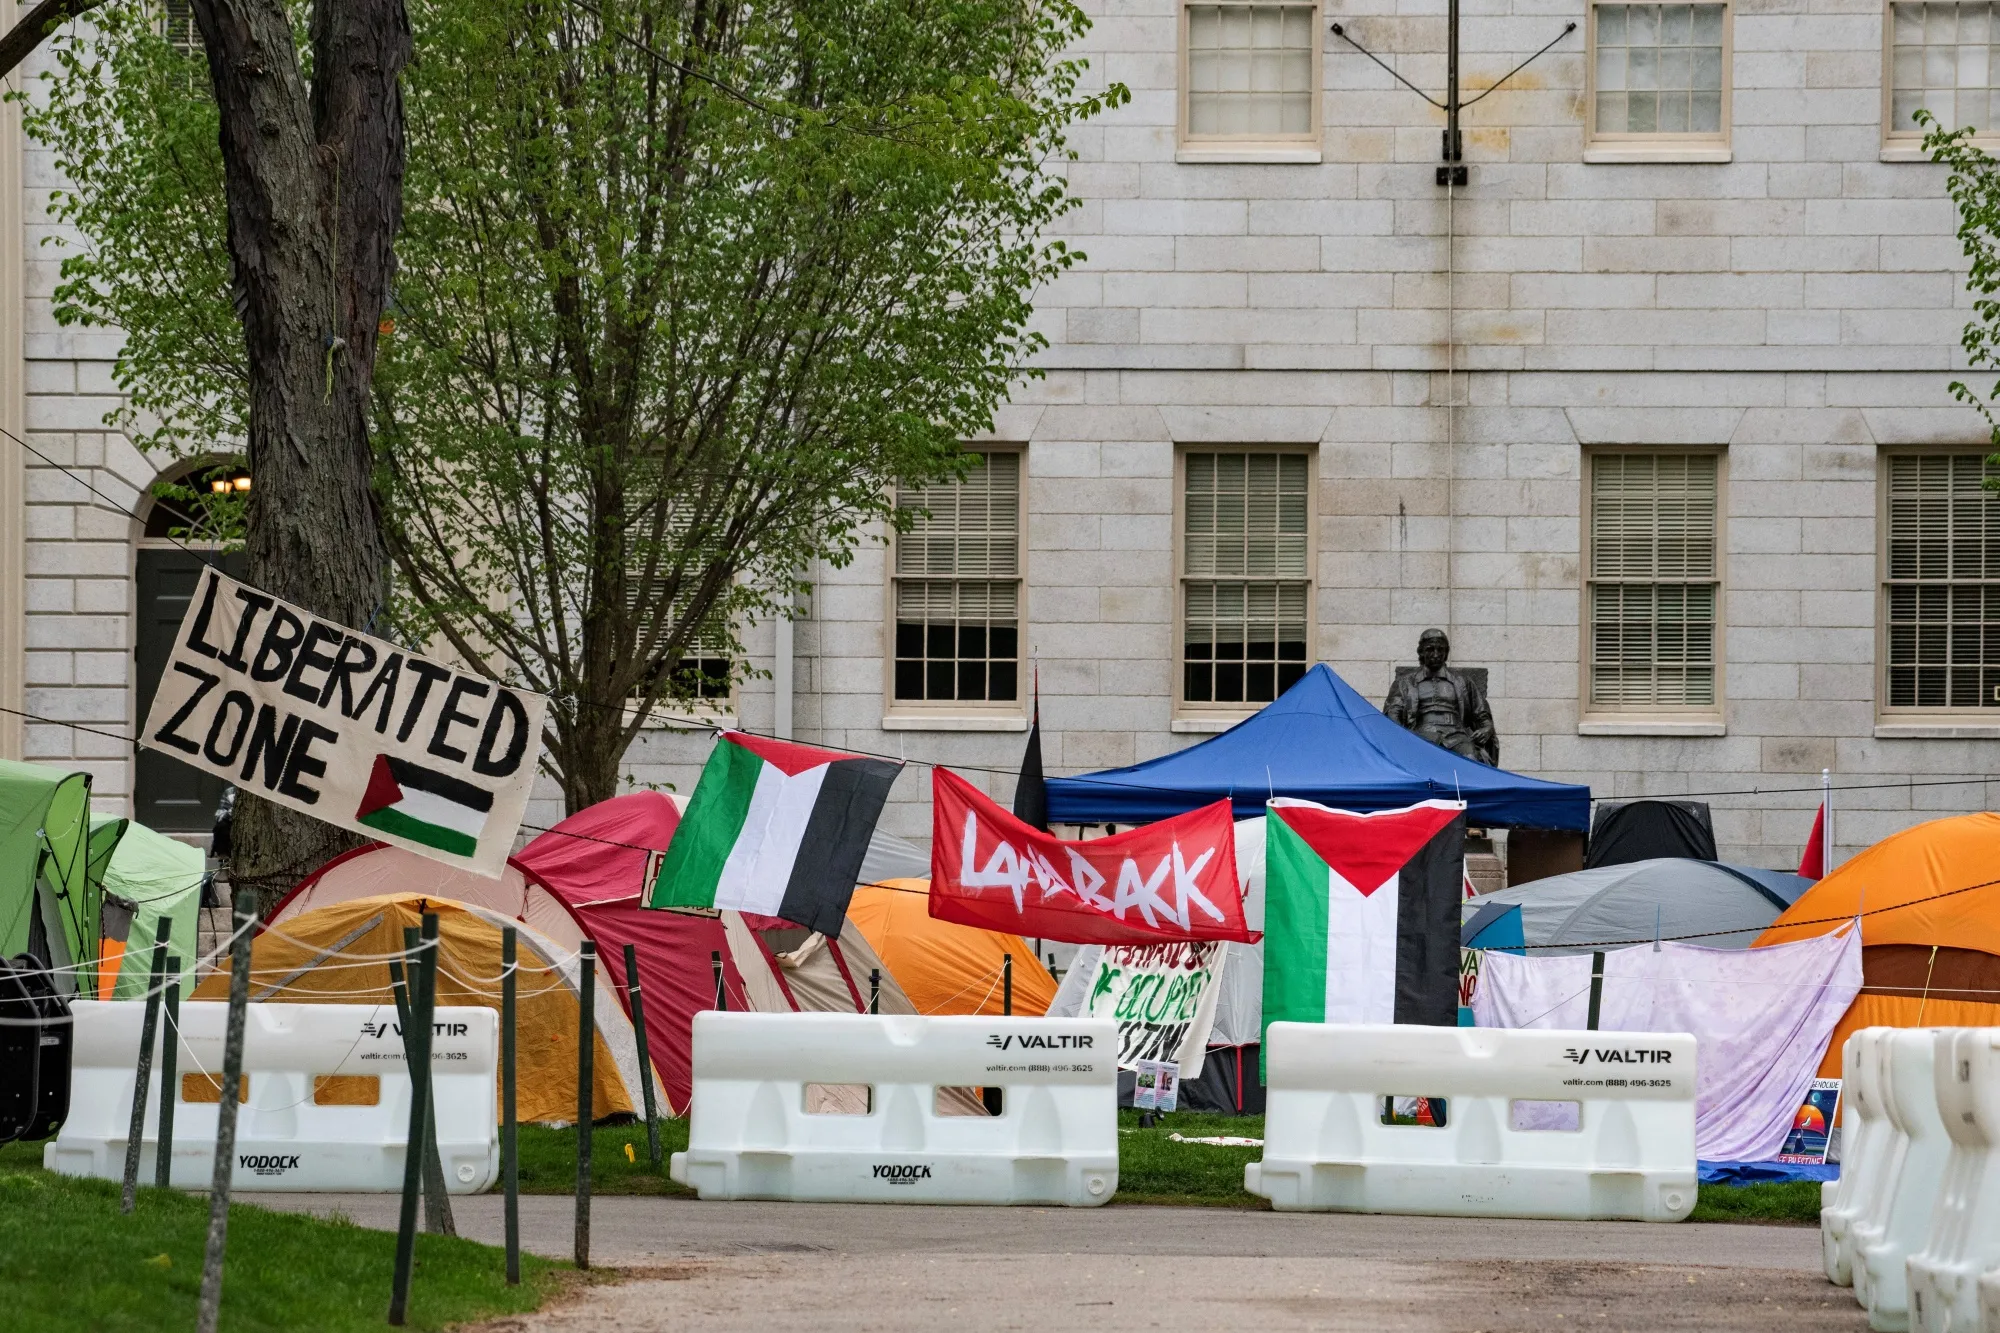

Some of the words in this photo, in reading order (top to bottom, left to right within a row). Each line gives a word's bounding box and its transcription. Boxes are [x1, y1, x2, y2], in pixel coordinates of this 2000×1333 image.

[187, 573, 529, 777] LIBERATED
[155, 661, 338, 804] ZONE
[1065, 840, 1224, 931] BACK
[393, 1023, 468, 1036] VTIR
[1018, 1036, 1094, 1049] VALTIR
[361, 1052, 400, 1060] valtir.com
[432, 1052, 468, 1060] 96-3625
[1595, 1049, 1672, 1063] VALTIR
[1028, 1065, 1050, 1073] (888)
[1563, 1078, 1603, 1086] valtir.com
[1605, 1079, 1628, 1087] (888)
[240, 1155, 300, 1169] YODOCK
[873, 1165, 932, 1178] YODOCK
